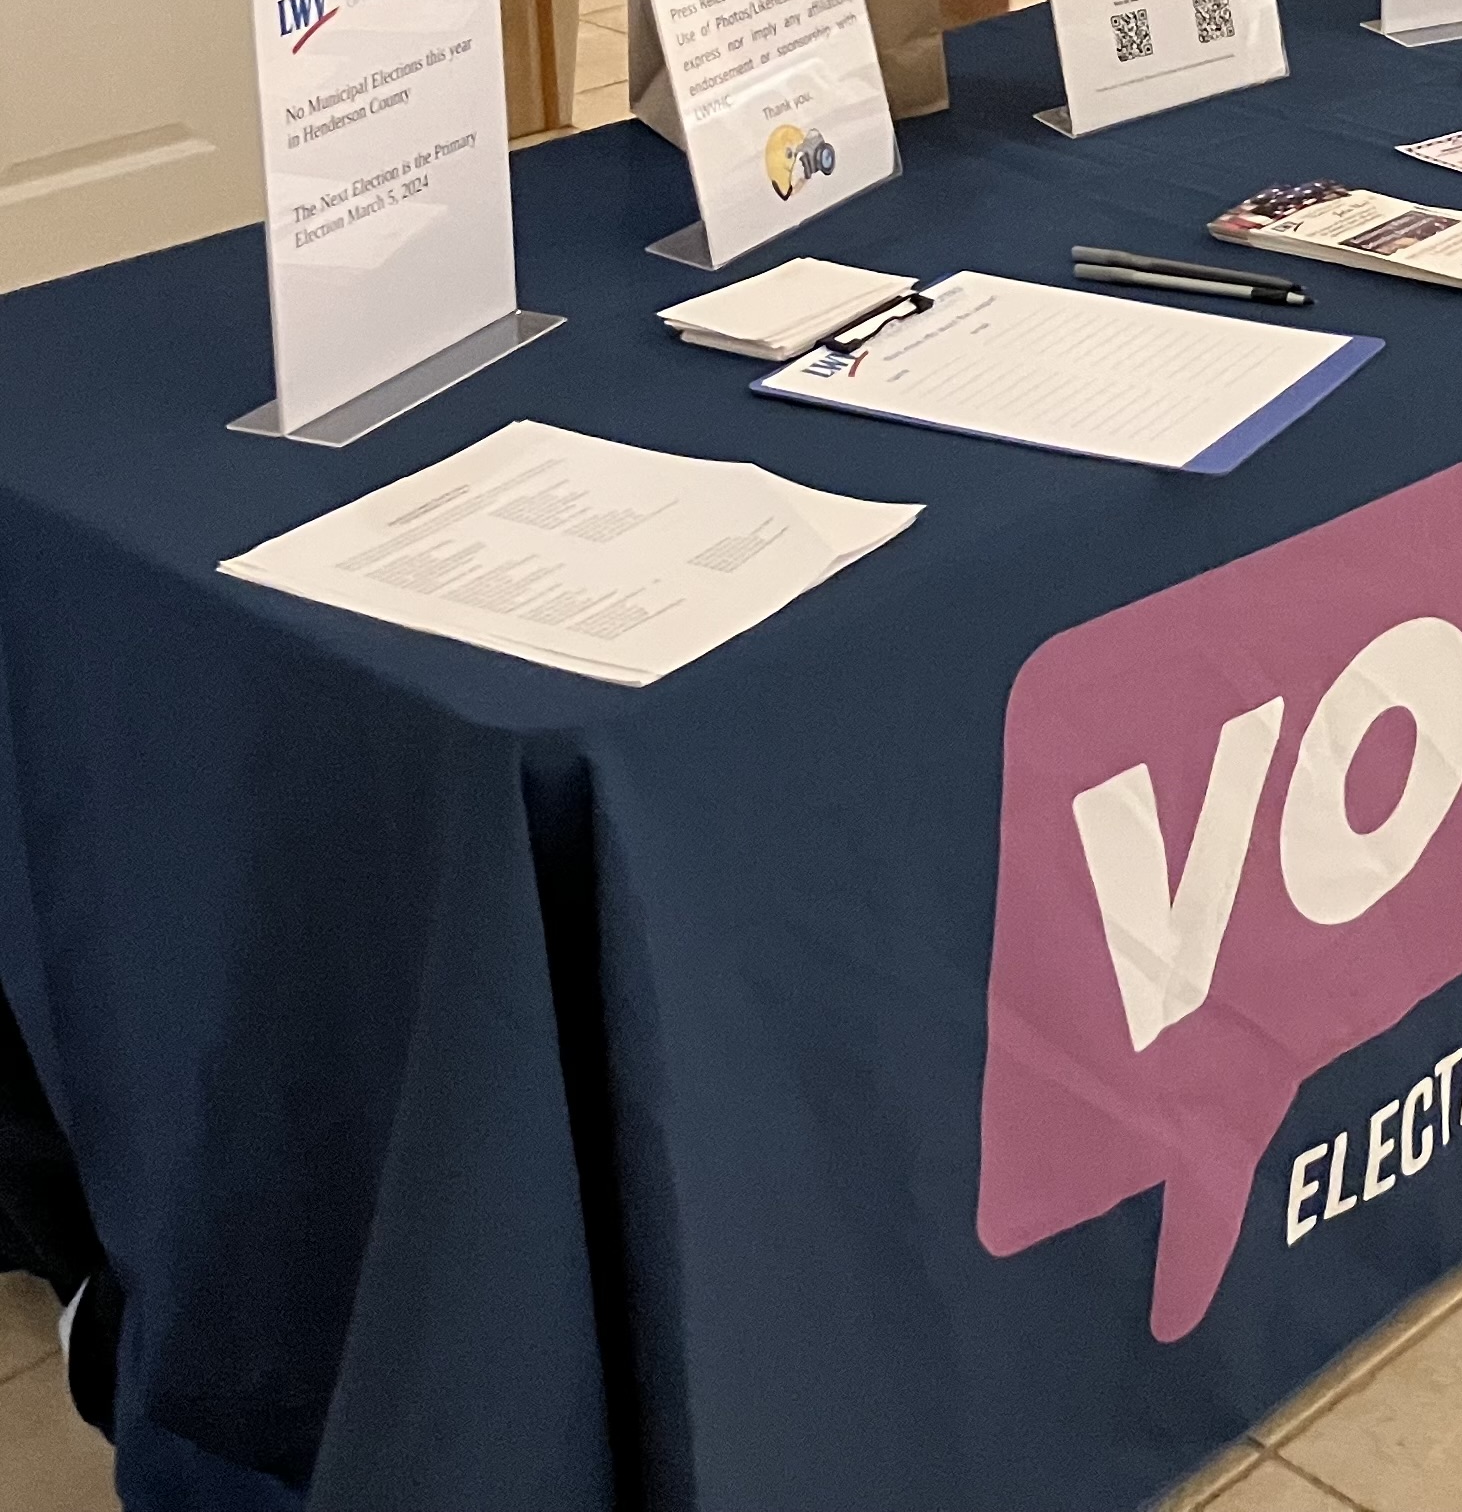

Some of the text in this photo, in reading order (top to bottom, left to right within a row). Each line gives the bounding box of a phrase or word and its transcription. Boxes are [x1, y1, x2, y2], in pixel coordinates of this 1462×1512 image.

[670, 3, 698, 22] Press
[676, 29, 696, 47] Use
[701, 20, 710, 37] of
[683, 46, 722, 72] express
[727, 36, 744, 53] nor
[751, 22, 777, 44] imply
[784, 13, 801, 29] any
[286, 38, 472, 125] No Municipal Elections this year
[689, 58, 754, 97] endorsement
[760, 51, 770, 65] or
[288, 87, 411, 150] in Henderson County
[762, 97, 792, 121] Thank
[293, 131, 477, 224] The Next Election is the Primary
[295, 173, 429, 249] Election March 5, 2024
